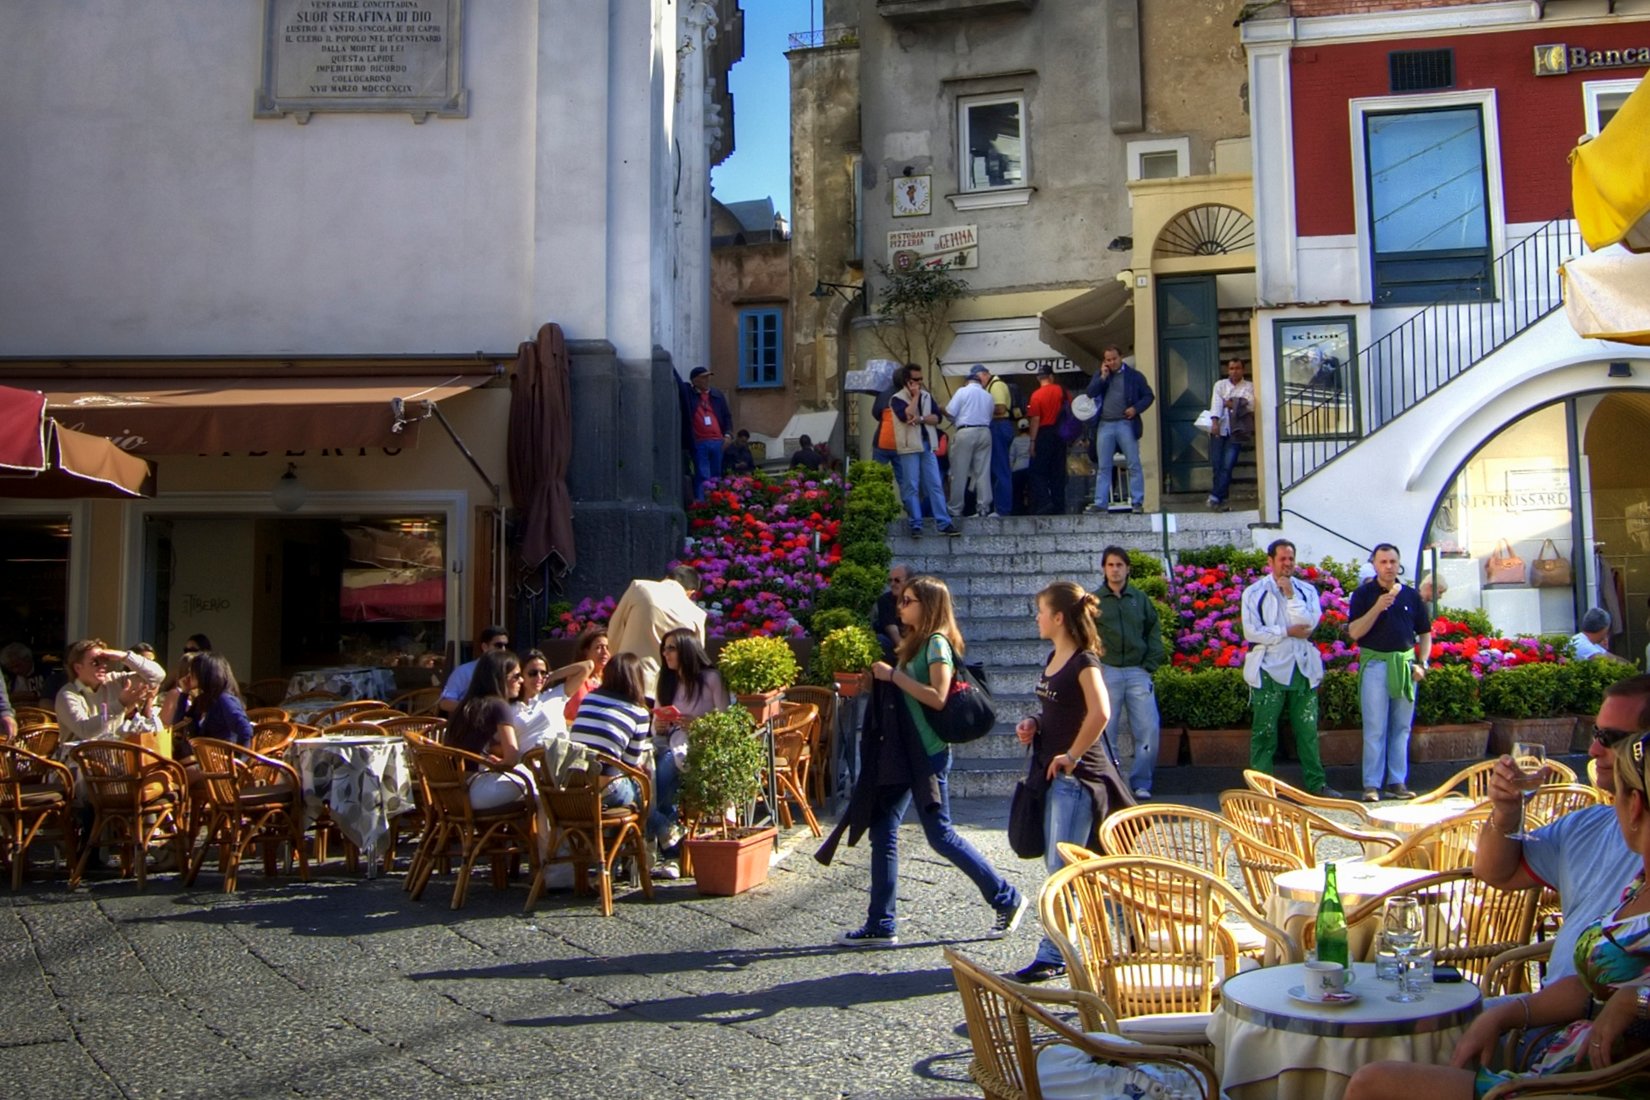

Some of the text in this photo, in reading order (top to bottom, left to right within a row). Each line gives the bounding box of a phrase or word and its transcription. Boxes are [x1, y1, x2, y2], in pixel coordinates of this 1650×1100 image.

[310, 1, 418, 9] VENERABILE CONCITTADINA
[297, 11, 432, 22] SUOR SERAFINA DI DIO
[286, 25, 318, 33] LUSTRO
[320, 25, 327, 33] E
[329, 25, 355, 33] VANTO
[406, 25, 415, 33] DI
[417, 25, 441, 33] CAPRI
[296, 35, 323, 43] CLERO
[335, 35, 367, 43] POPOLO
[321, 45, 405, 53] DALLA MORTE DI LEI
[331, 55, 364, 64] QUESTA
[1570, 47, 1650, 68] Banca
[316, 65, 407, 73] IMPERITURO RICORDO
[331, 75, 392, 83] COLLOCARONO
[330, 85, 358, 93] MARZO
[889, 230, 935, 240] RISTORANTE
[939, 229, 975, 249] GEMMA
[889, 239, 924, 248] PIZZERIA
